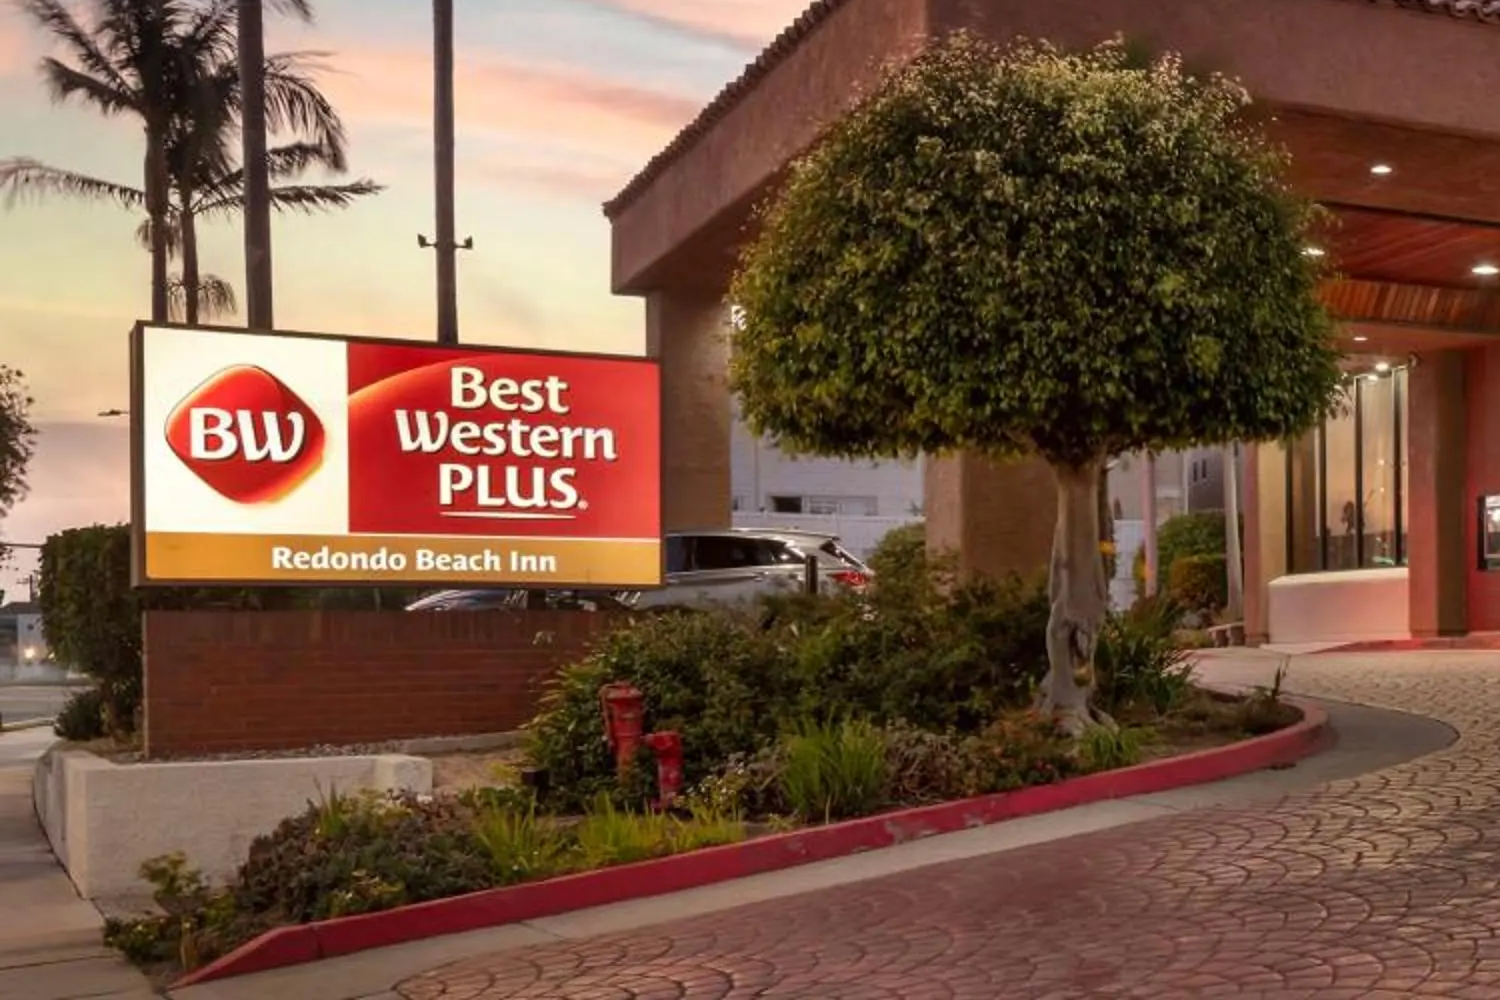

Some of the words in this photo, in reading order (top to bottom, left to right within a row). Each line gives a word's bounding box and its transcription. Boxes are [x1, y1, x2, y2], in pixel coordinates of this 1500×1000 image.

[451, 366, 570, 413] Best
[190, 407, 304, 462] BW
[395, 408, 618, 460] Western
[271, 546, 407, 571] Redondo
[415, 549, 501, 572] Beach
[510, 551, 557, 573] Inn
